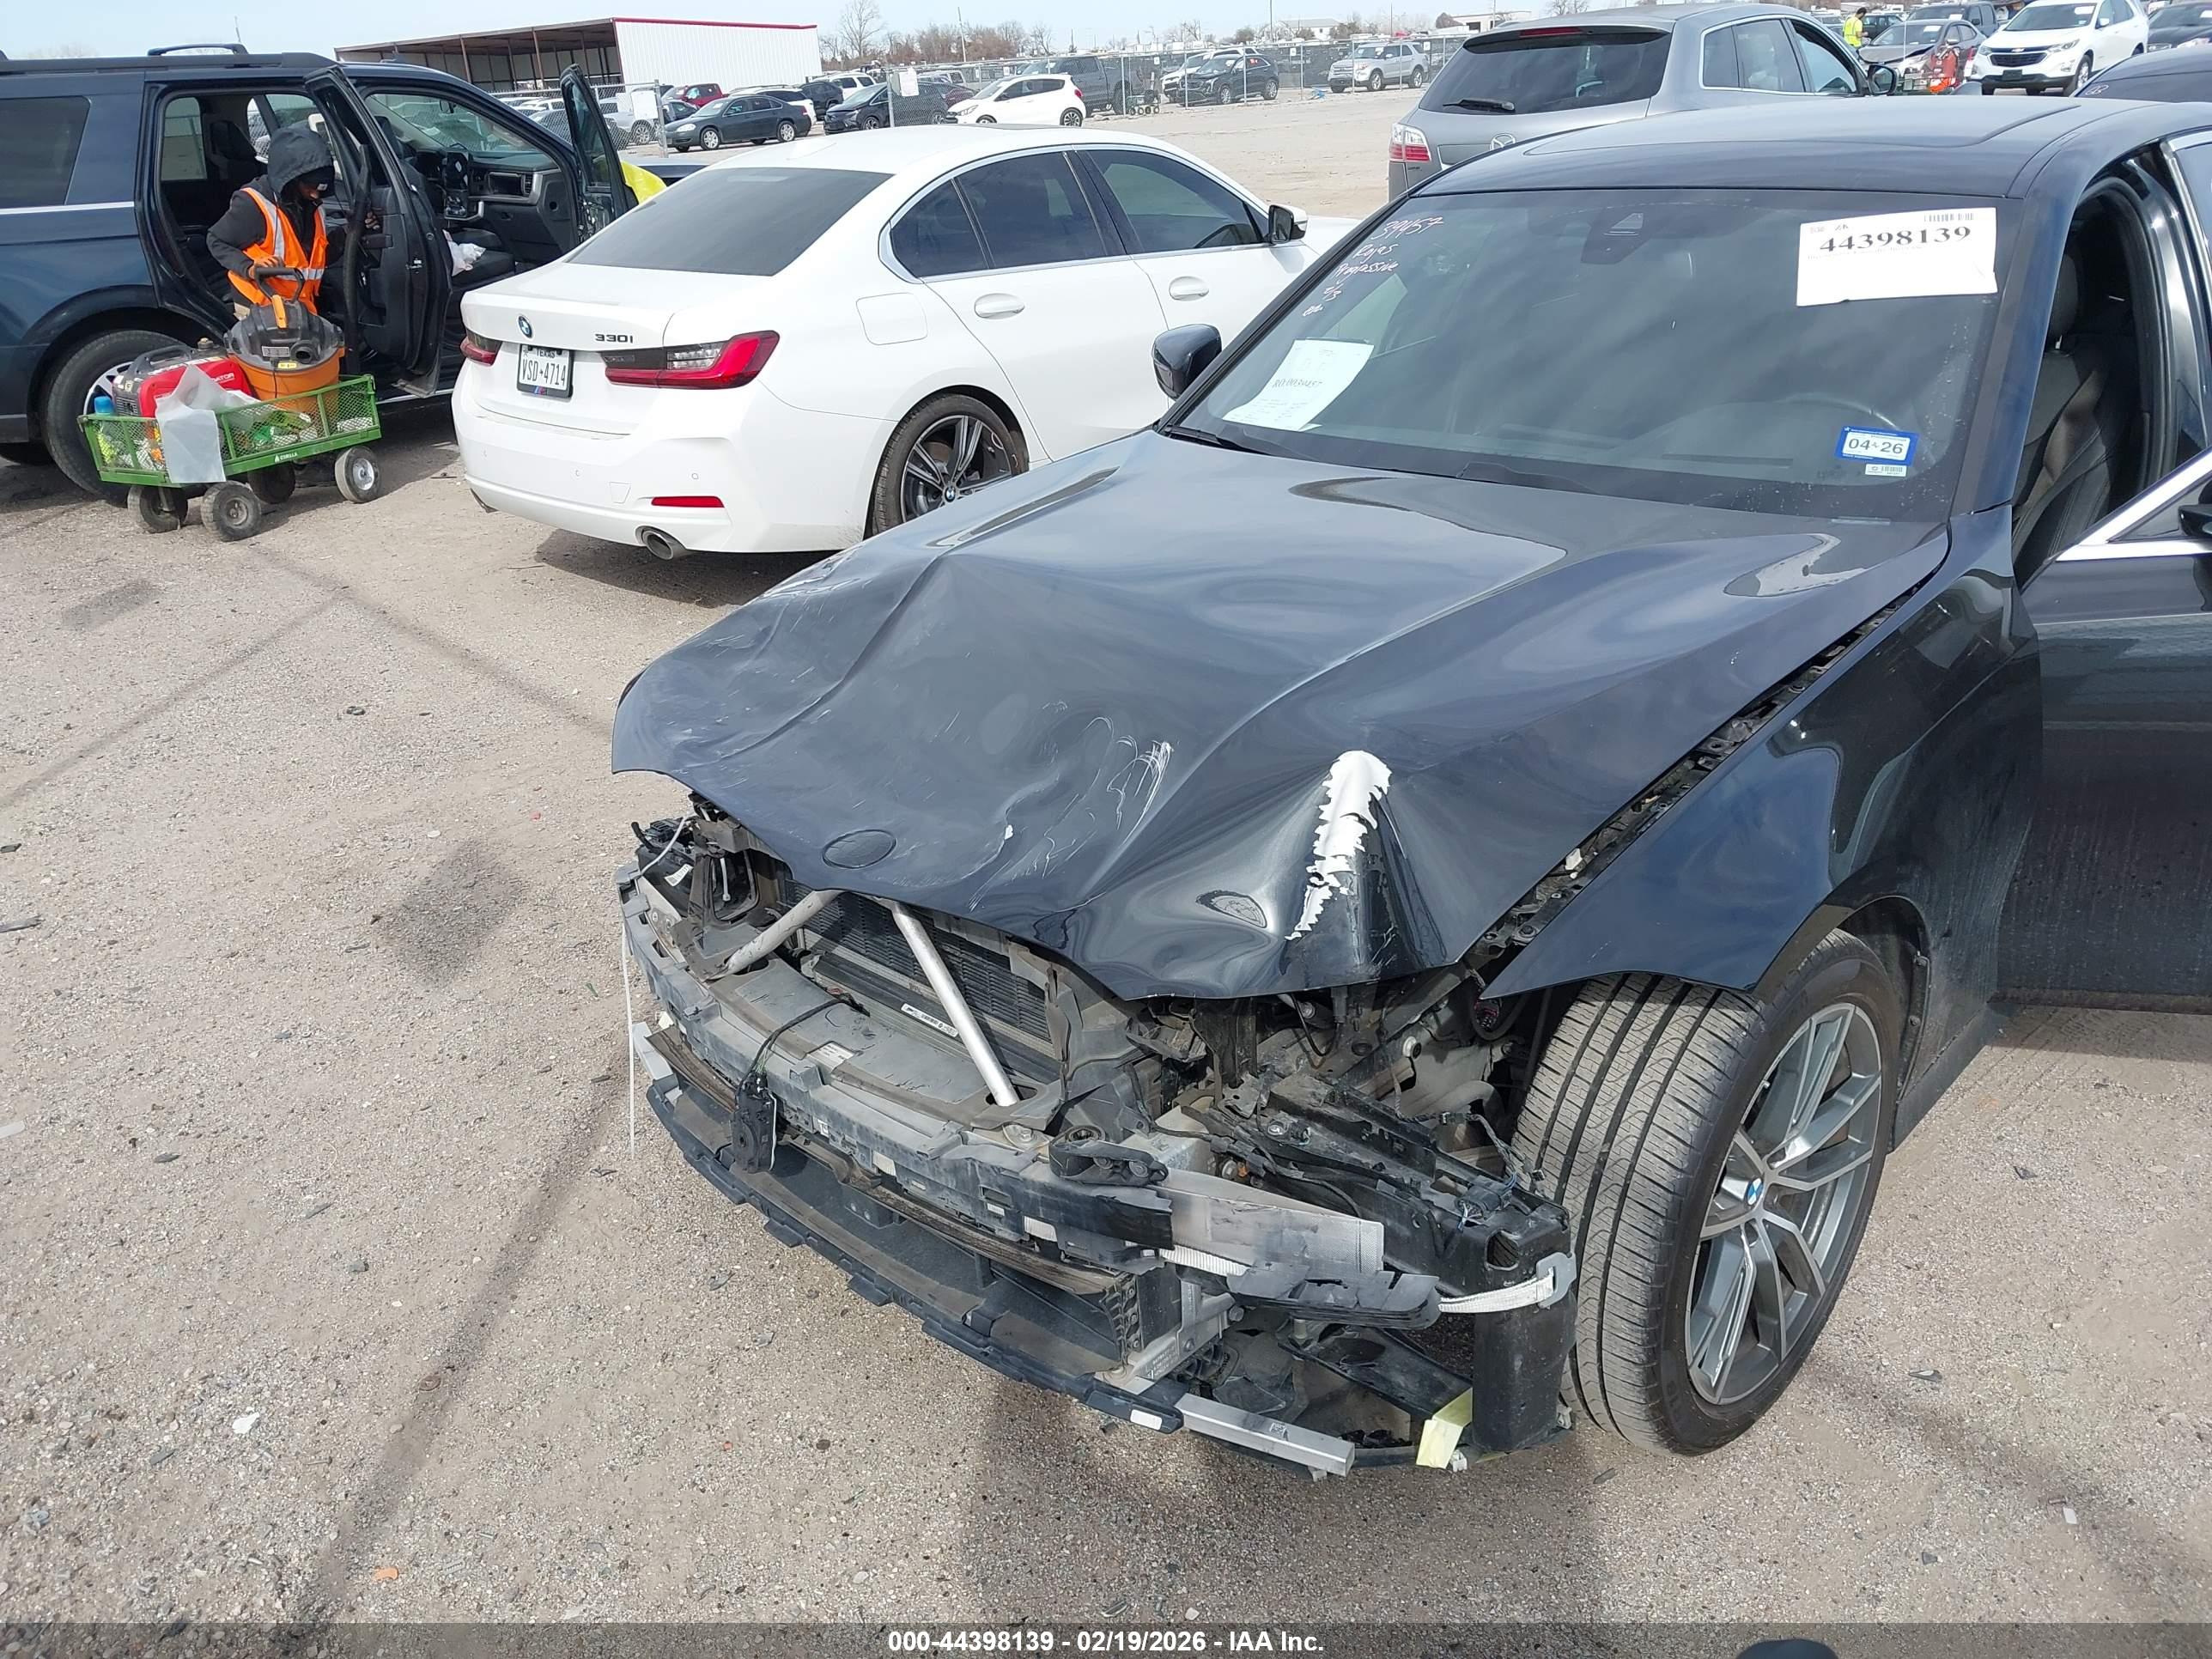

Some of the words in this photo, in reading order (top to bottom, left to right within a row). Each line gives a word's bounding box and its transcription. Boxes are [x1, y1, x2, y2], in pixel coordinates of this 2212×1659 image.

[1371, 216, 1444, 240] 39457
[1820, 226, 1972, 252] 44398139
[536, 349, 556, 359] TEXAS
